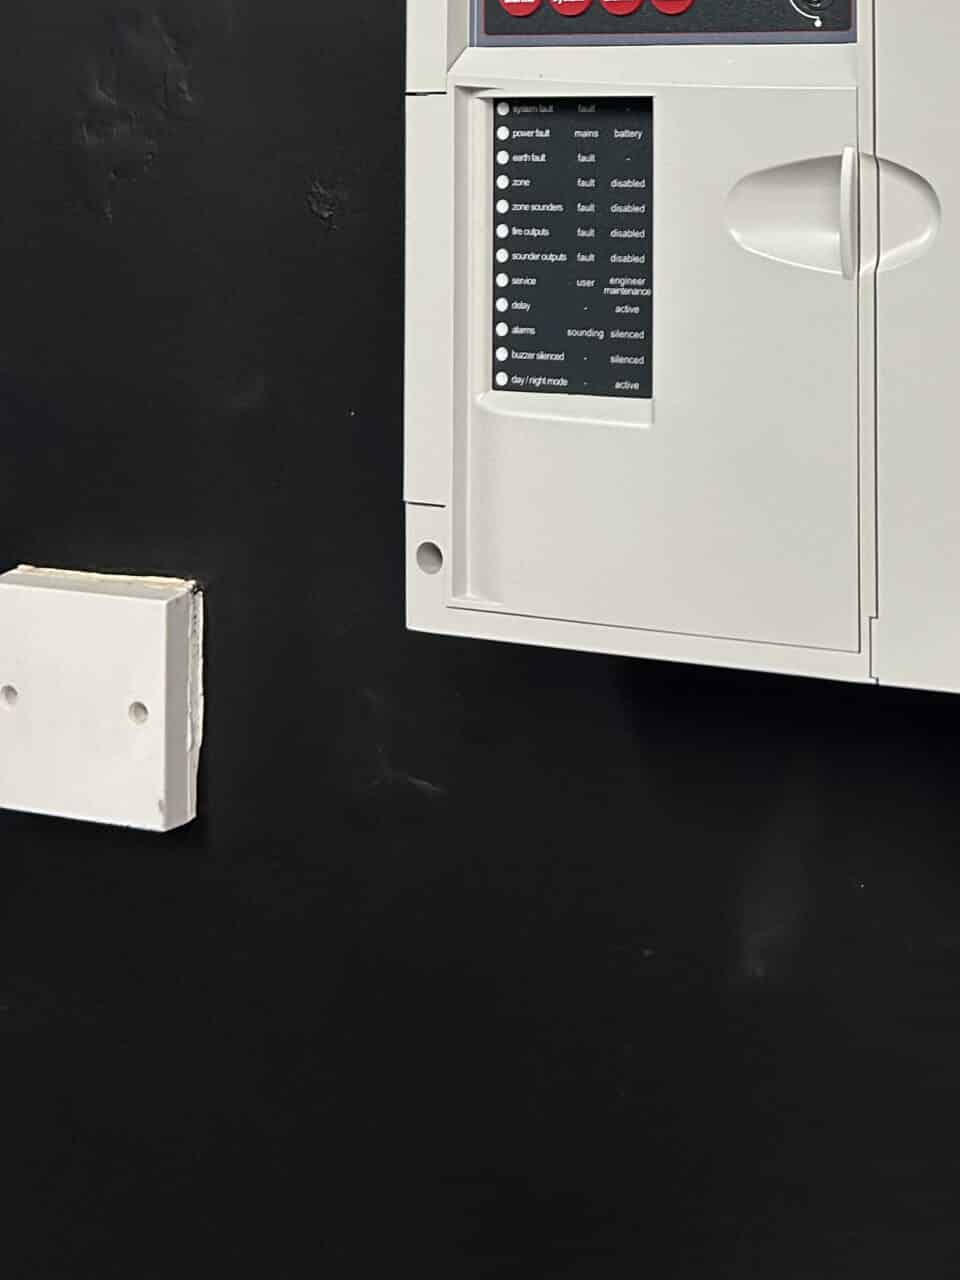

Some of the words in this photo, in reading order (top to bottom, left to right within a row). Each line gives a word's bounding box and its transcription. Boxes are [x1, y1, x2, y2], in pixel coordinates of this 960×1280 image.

[512, 130, 535, 139] power
[536, 129, 550, 137] fault
[614, 129, 642, 139] battery
[532, 154, 546, 162] fault
[577, 154, 596, 162] fault
[577, 178, 595, 187] fault
[611, 179, 645, 188] disabled
[531, 204, 563, 212] sounders
[577, 203, 595, 212] fault
[610, 204, 645, 213] disabled
[524, 228, 549, 236] outputs
[577, 228, 595, 237] fault
[610, 229, 645, 238] disabled
[512, 253, 540, 261] sounder
[541, 253, 567, 262] outputs
[577, 253, 595, 262] fault
[610, 254, 645, 263] disabled
[512, 277, 536, 285] service
[576, 279, 595, 287] user
[609, 277, 646, 286] engineer
[604, 287, 651, 296] maintenance
[615, 305, 639, 314] active
[567, 329, 604, 339] sounding
[610, 330, 644, 339] silenced
[536, 351, 564, 361] silenced
[610, 355, 644, 365] silenced
[615, 381, 639, 390] active
